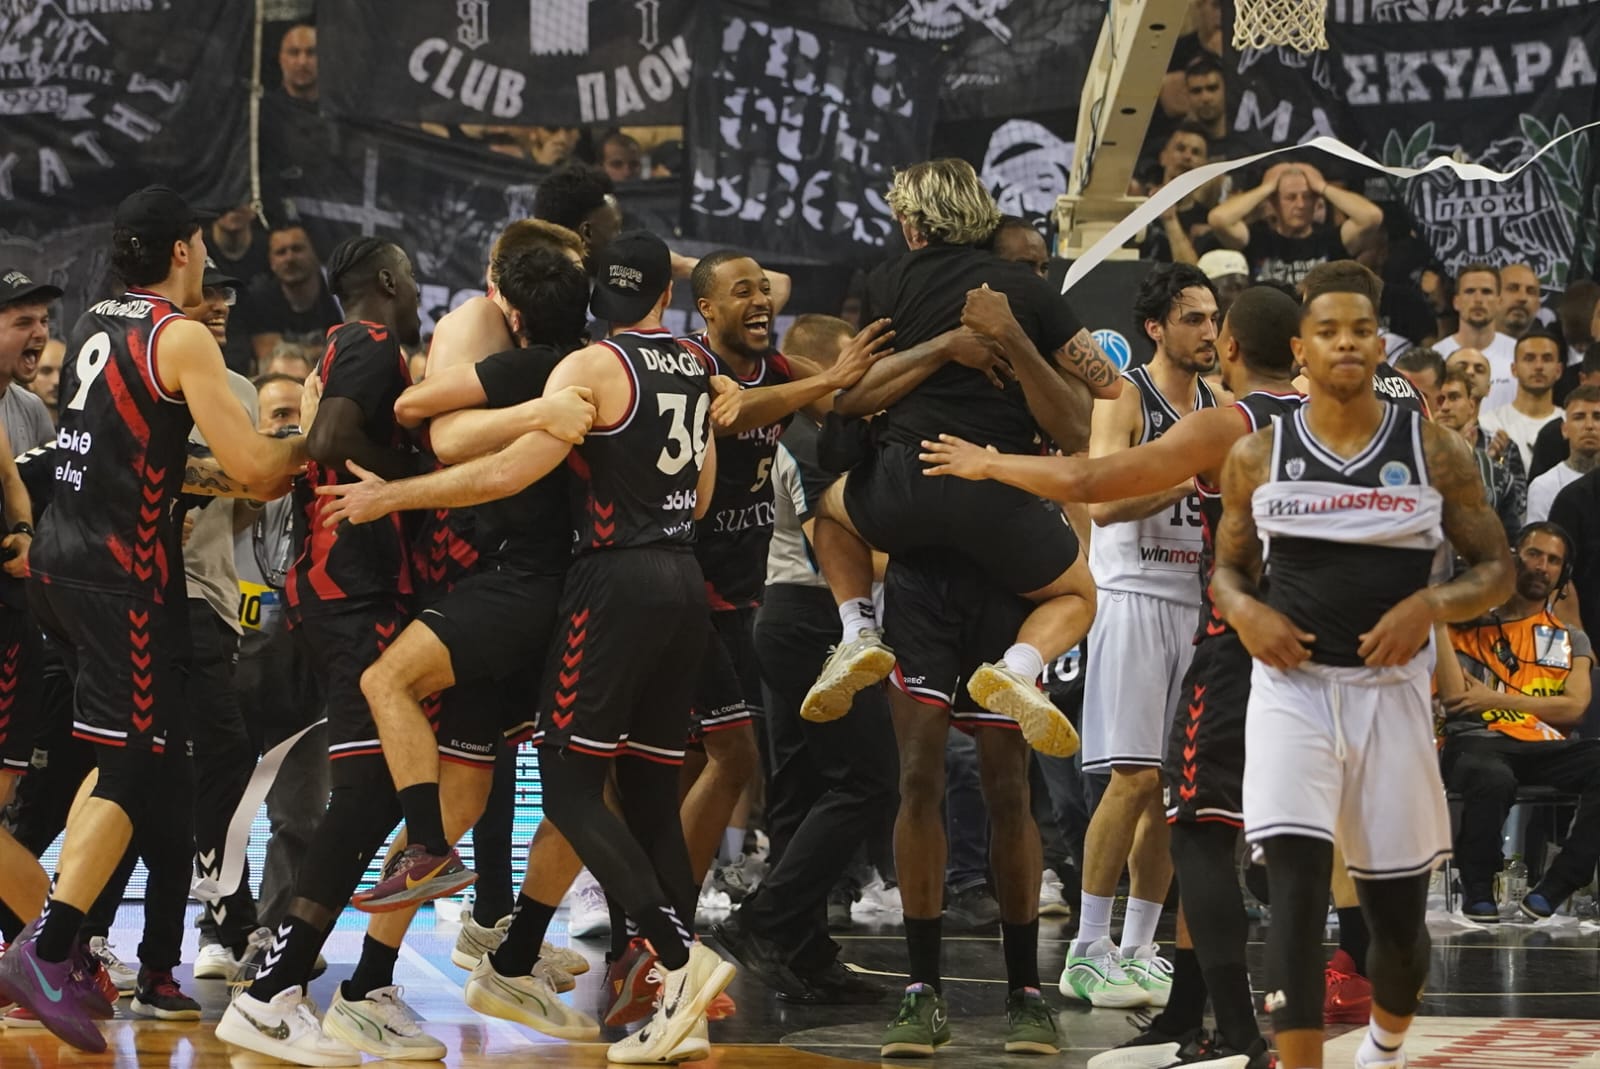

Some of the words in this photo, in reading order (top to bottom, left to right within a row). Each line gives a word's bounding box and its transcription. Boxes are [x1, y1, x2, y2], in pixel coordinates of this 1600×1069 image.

[408, 37, 527, 119] CLUB
[1342, 36, 1597, 106] ΣΚΥΔΡΑ
[1439, 195, 1521, 218] ΠΑΟΚ
[67, 331, 111, 411] 9
[750, 457, 772, 493] 5
[451, 738, 460, 748] EL
[460, 741, 490, 753] CORREO
